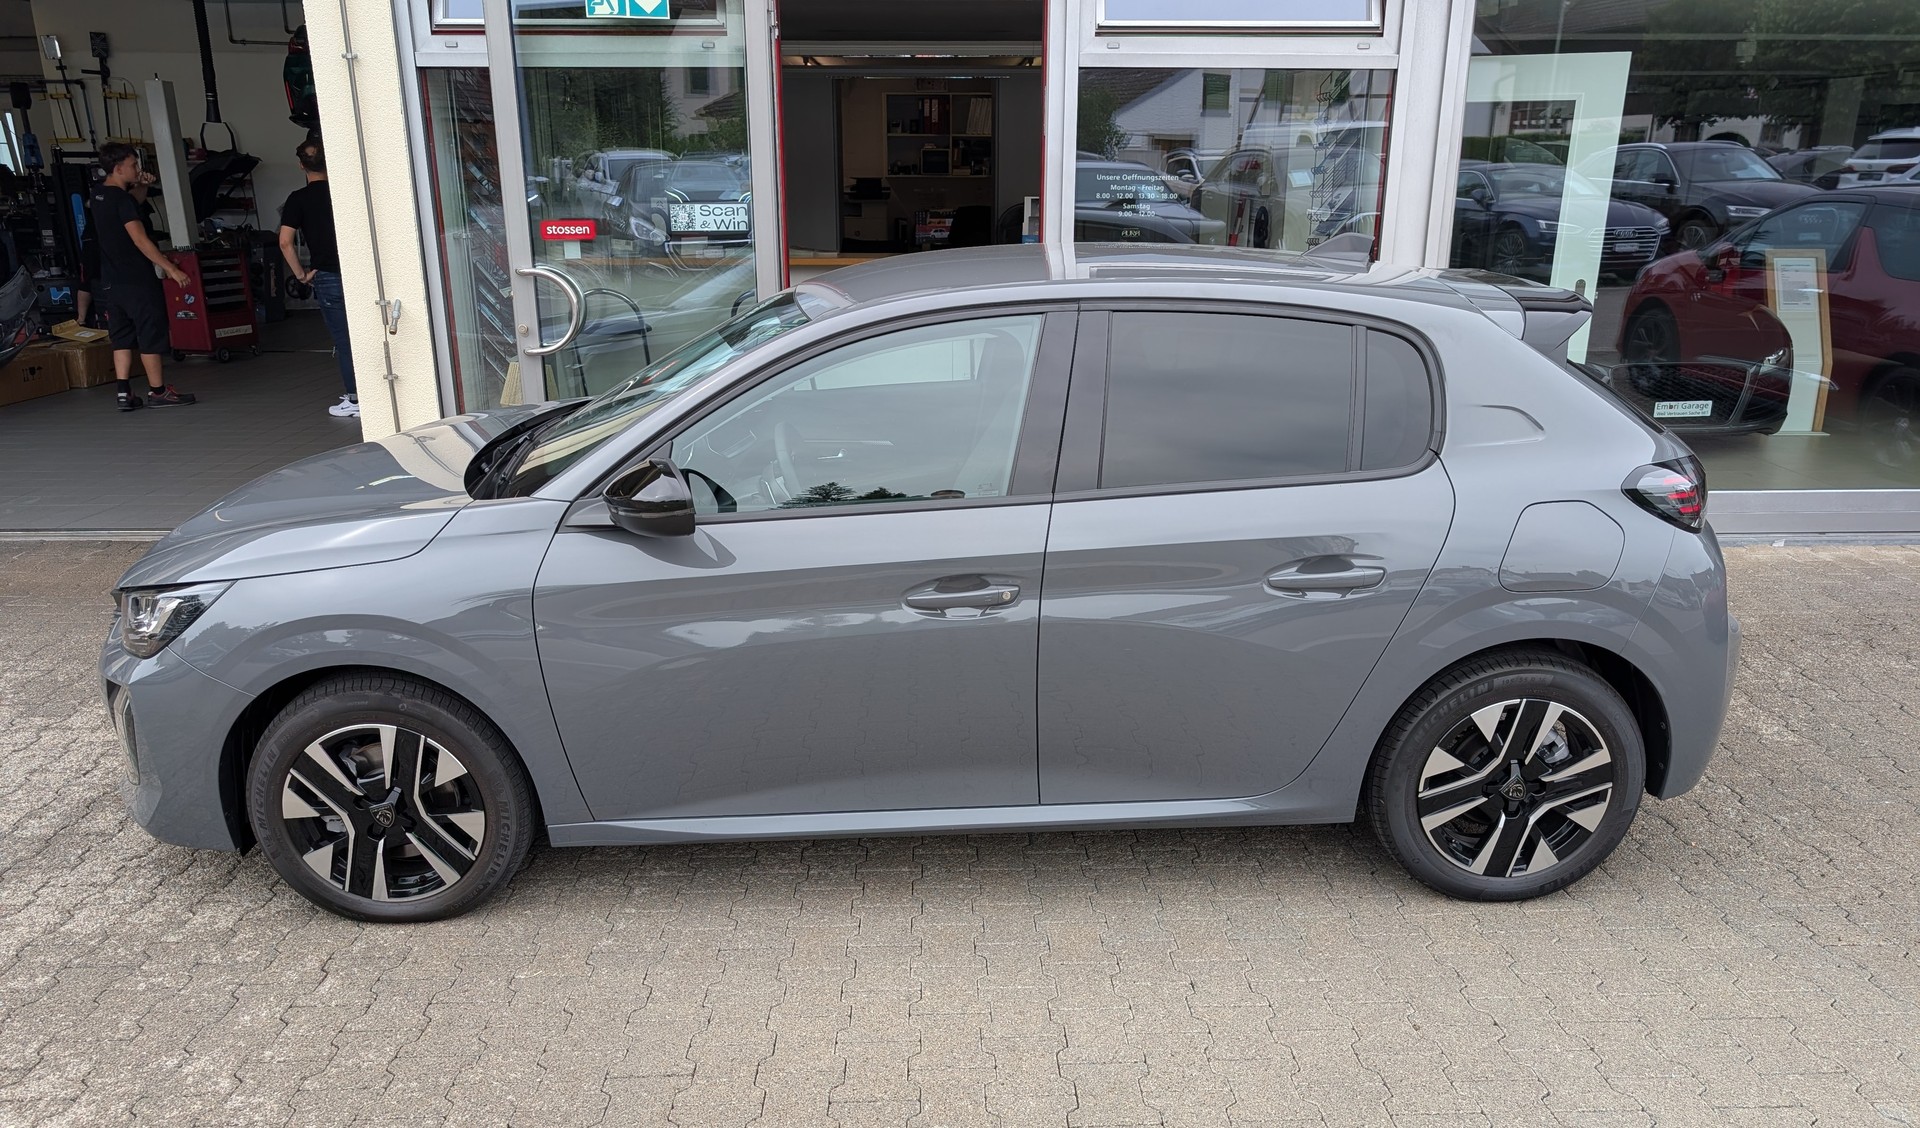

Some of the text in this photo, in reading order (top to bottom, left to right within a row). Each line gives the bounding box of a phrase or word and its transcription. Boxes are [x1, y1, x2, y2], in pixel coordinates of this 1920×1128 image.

[1122, 174, 1179, 182] Oeffnungszeiten
[1110, 184, 1136, 192] Montag
[1141, 184, 1165, 192] Freitag
[699, 204, 747, 217] Scan
[700, 217, 748, 230] & Win
[546, 225, 590, 235] stossen
[1681, 403, 1709, 411] Garage
[255, 748, 277, 831] MICHELIN
[489, 800, 511, 878] MICHELIN
